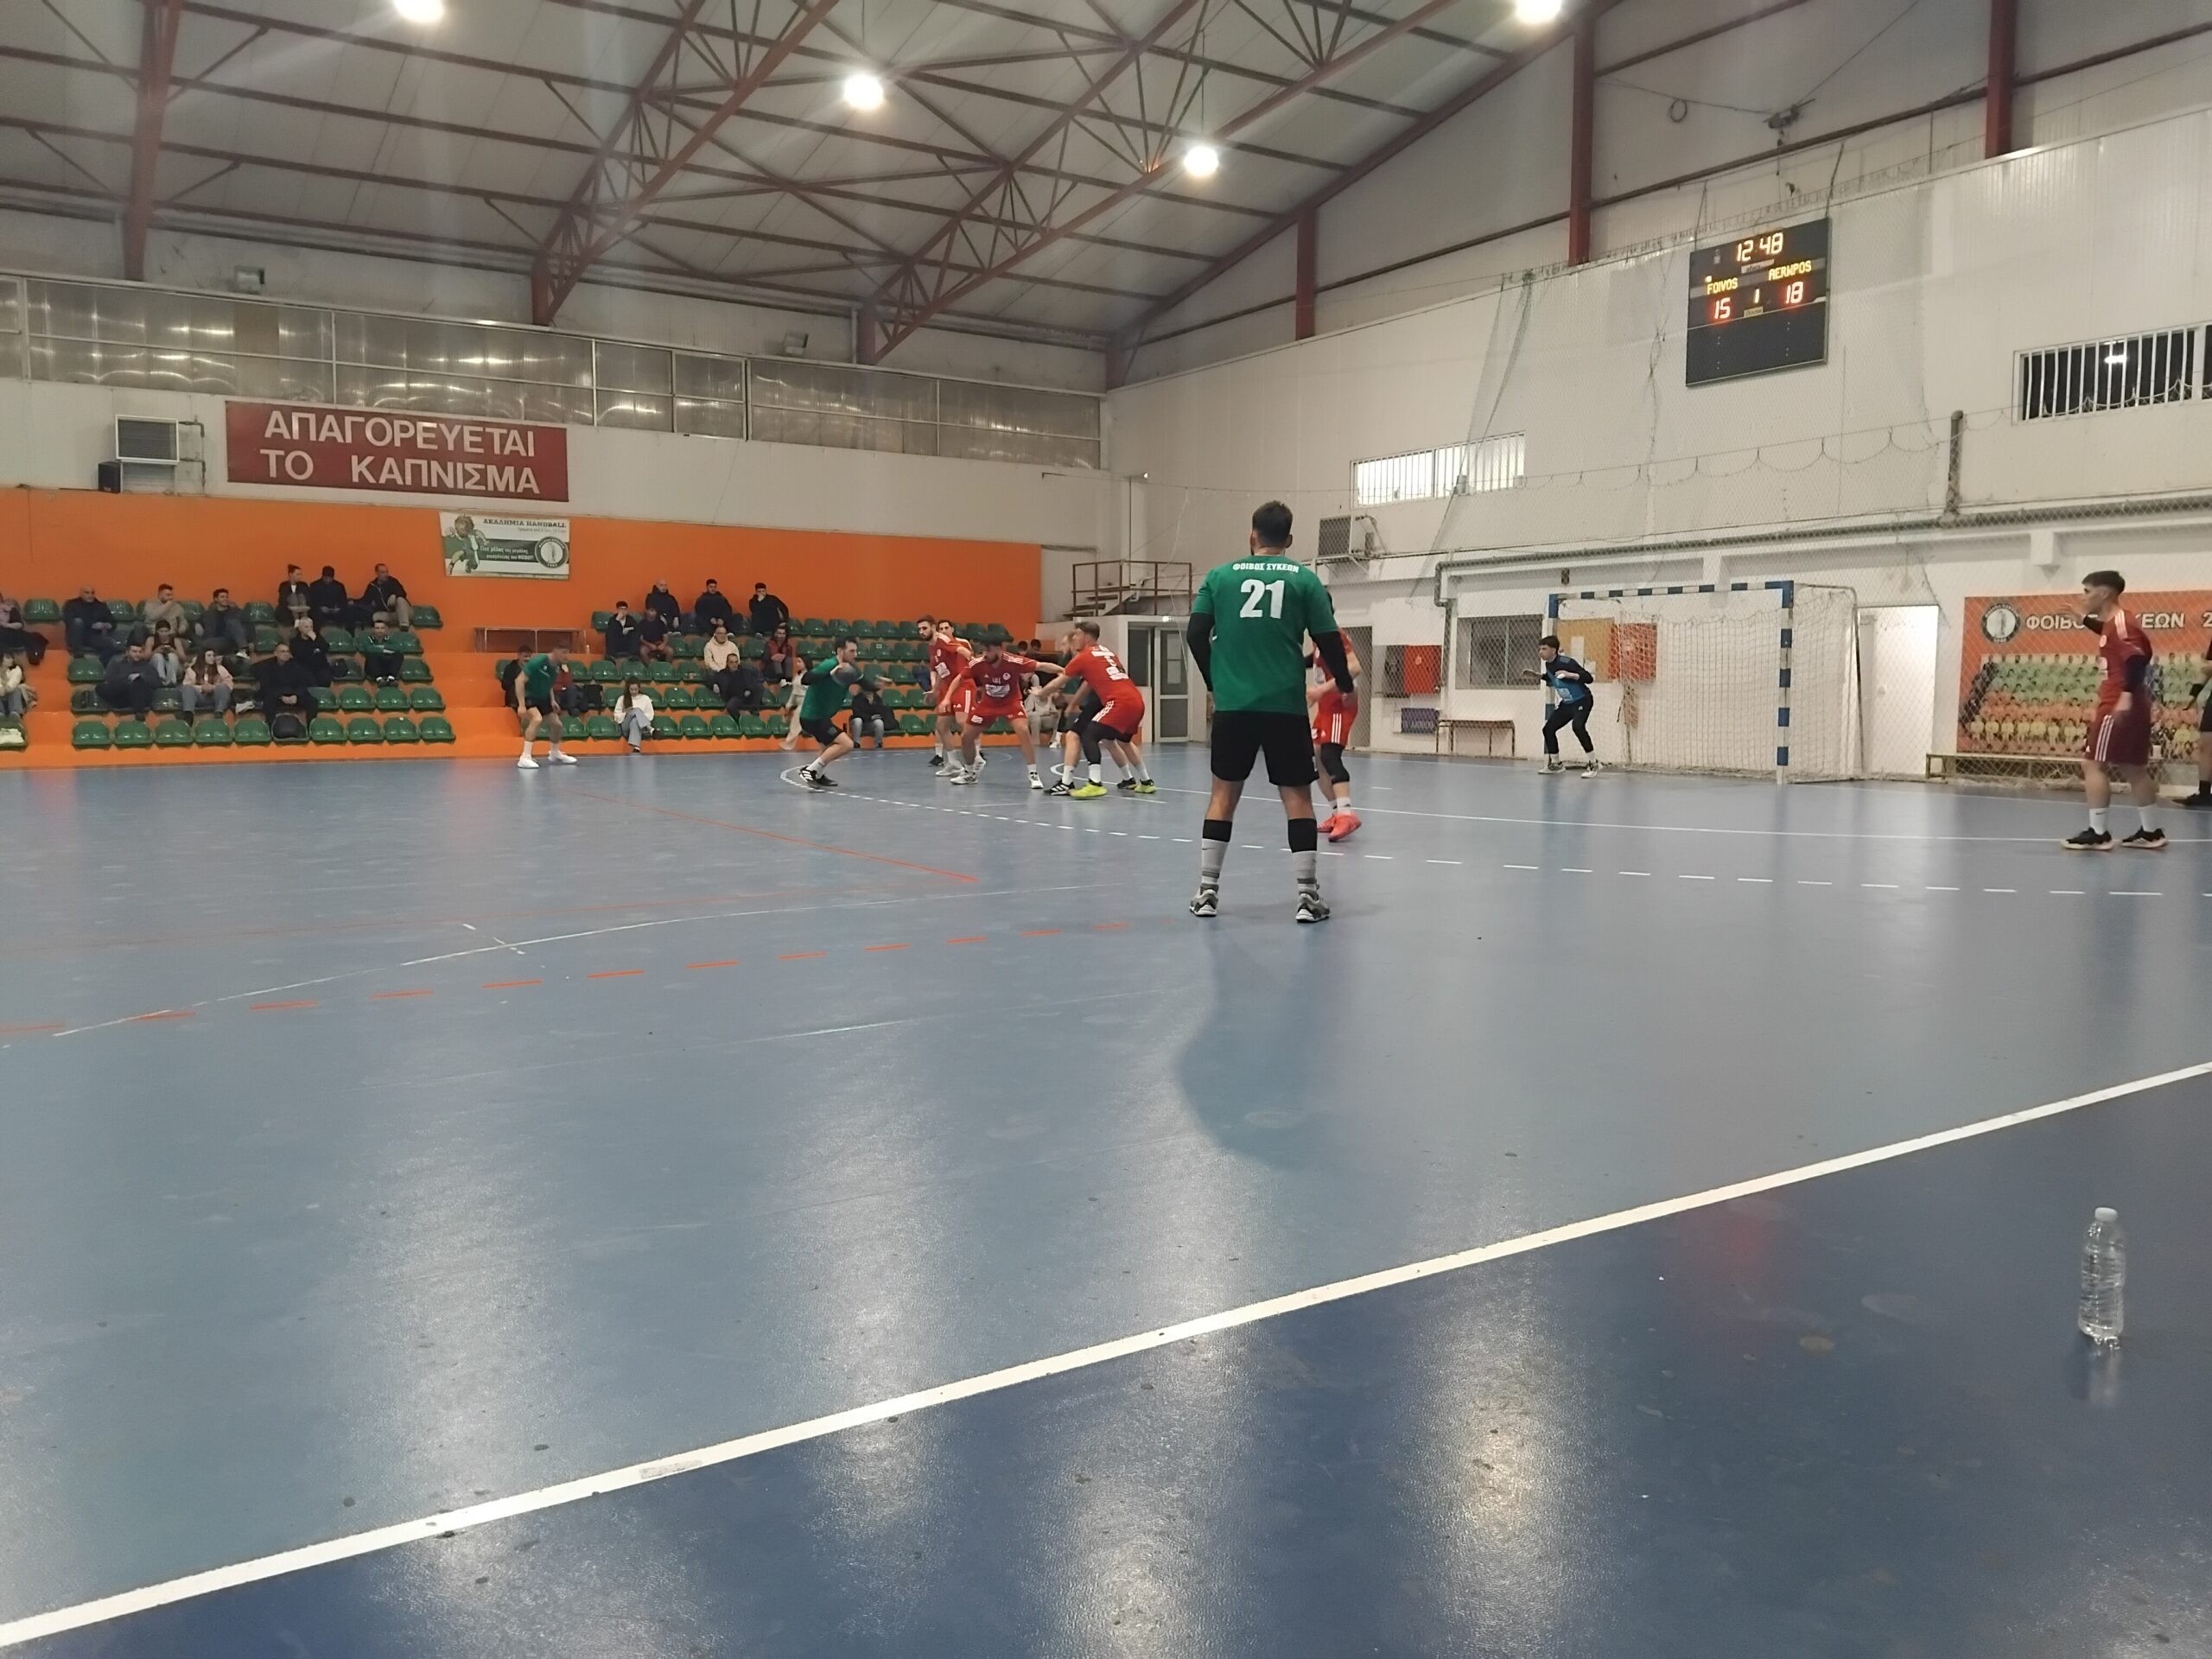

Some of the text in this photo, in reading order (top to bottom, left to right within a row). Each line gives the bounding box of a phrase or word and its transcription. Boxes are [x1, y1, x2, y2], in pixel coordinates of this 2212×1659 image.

[1707, 277, 1738, 296] FOIVOS
[1786, 282, 1804, 304] 18
[1714, 297, 1731, 319] 15
[264, 410, 535, 457] ΑΠΑΓΟΡΕΥΕΤΑΙ
[260, 449, 540, 494] ΤΟ ΚΑΠΝΙΣΜΑ
[1239, 579, 1285, 619] 21
[2025, 614, 2098, 631] ΦΟΙΒ
